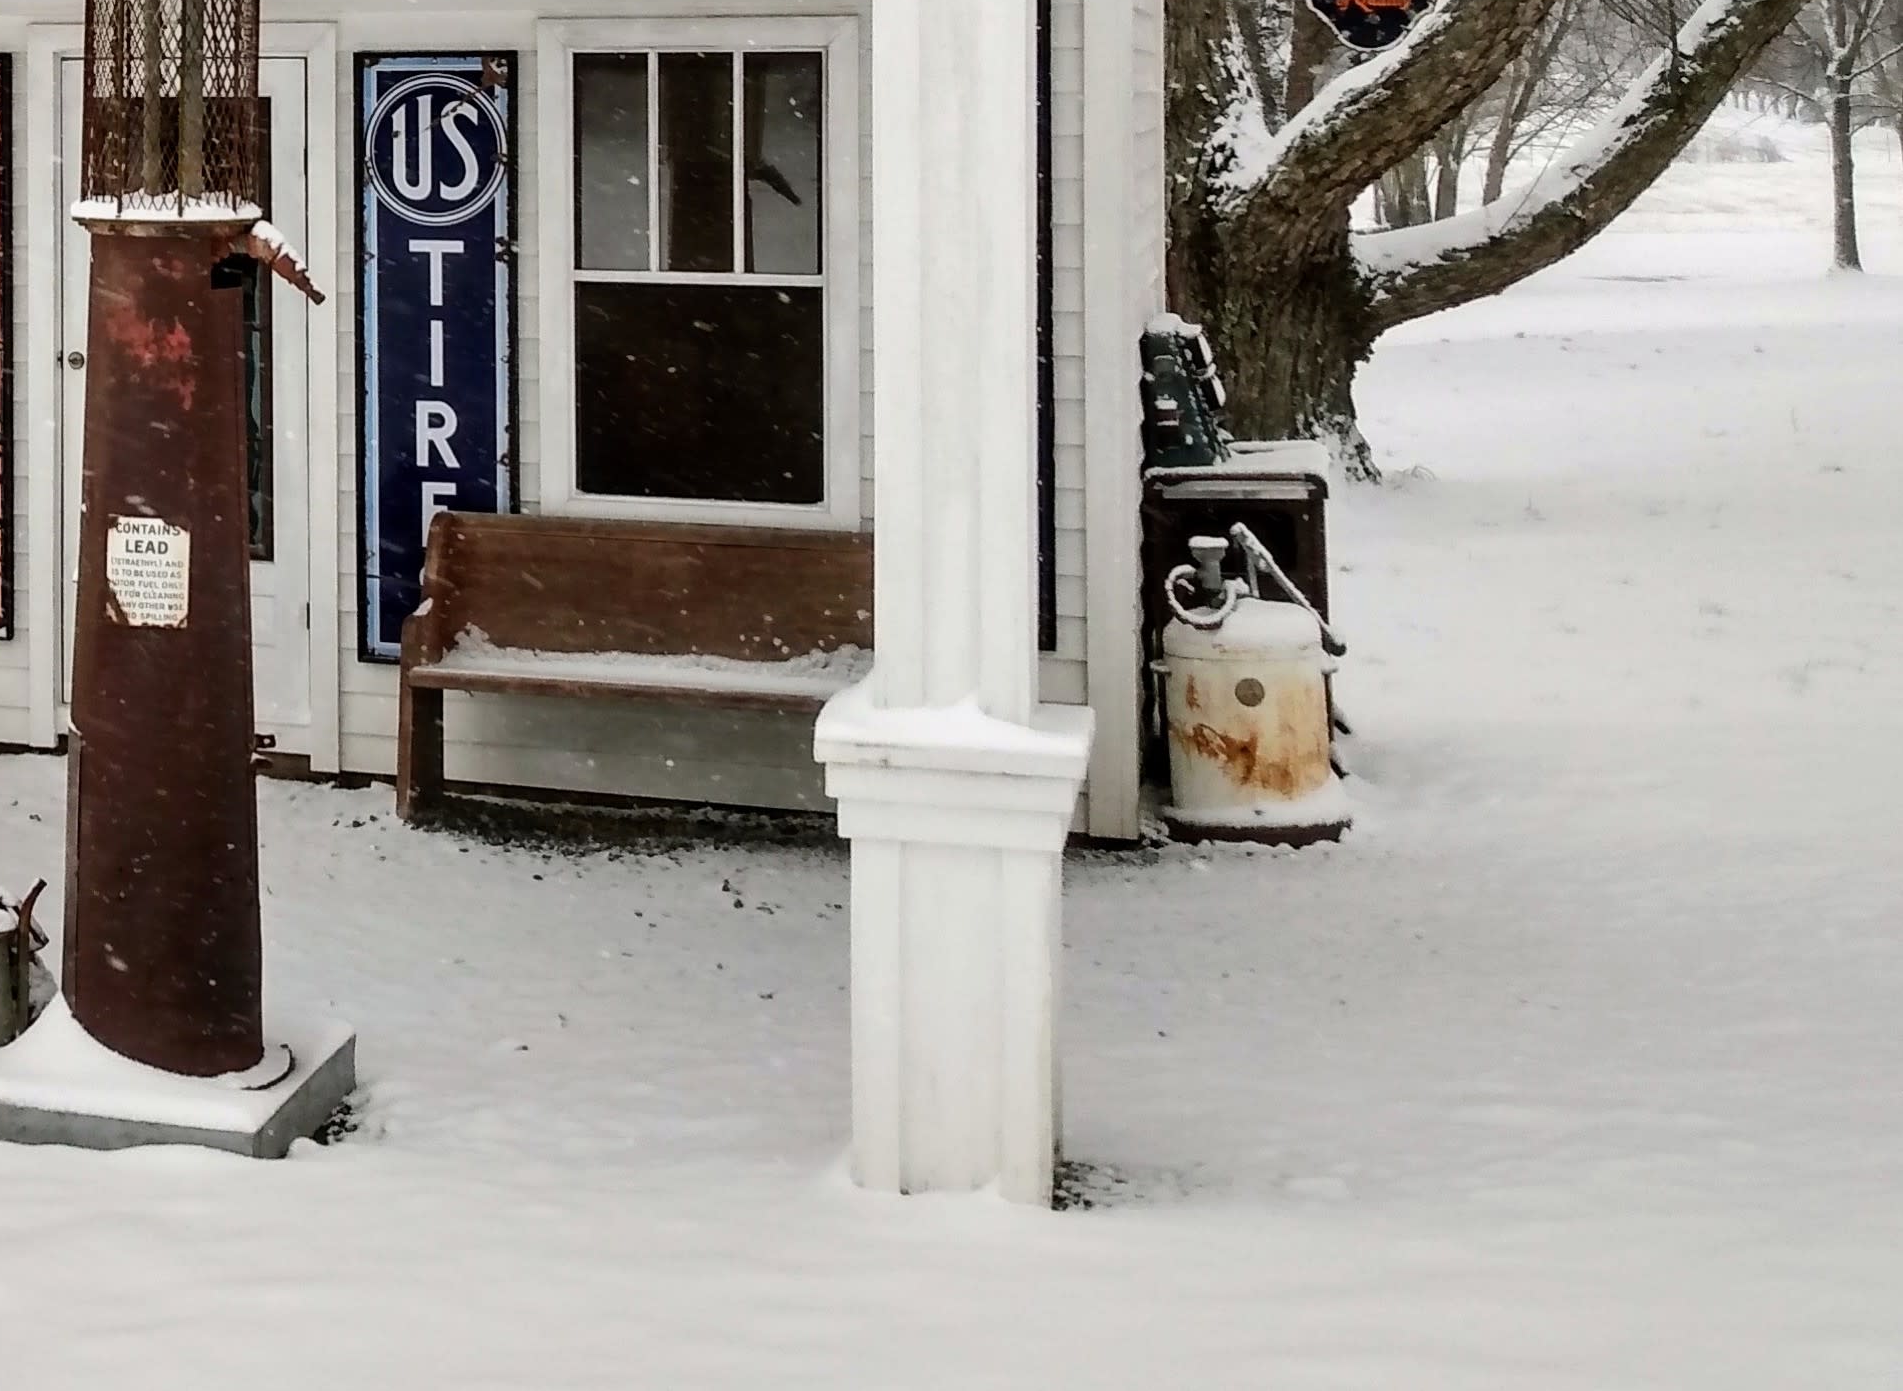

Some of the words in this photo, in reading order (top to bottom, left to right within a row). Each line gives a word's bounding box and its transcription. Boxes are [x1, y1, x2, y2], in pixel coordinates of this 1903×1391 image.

[391, 92, 480, 202] US
[115, 522, 181, 537] CONTAINS
[125, 539, 169, 555] LEAD
[122, 568, 132, 576] TO
[138, 580, 159, 589] FUEL
